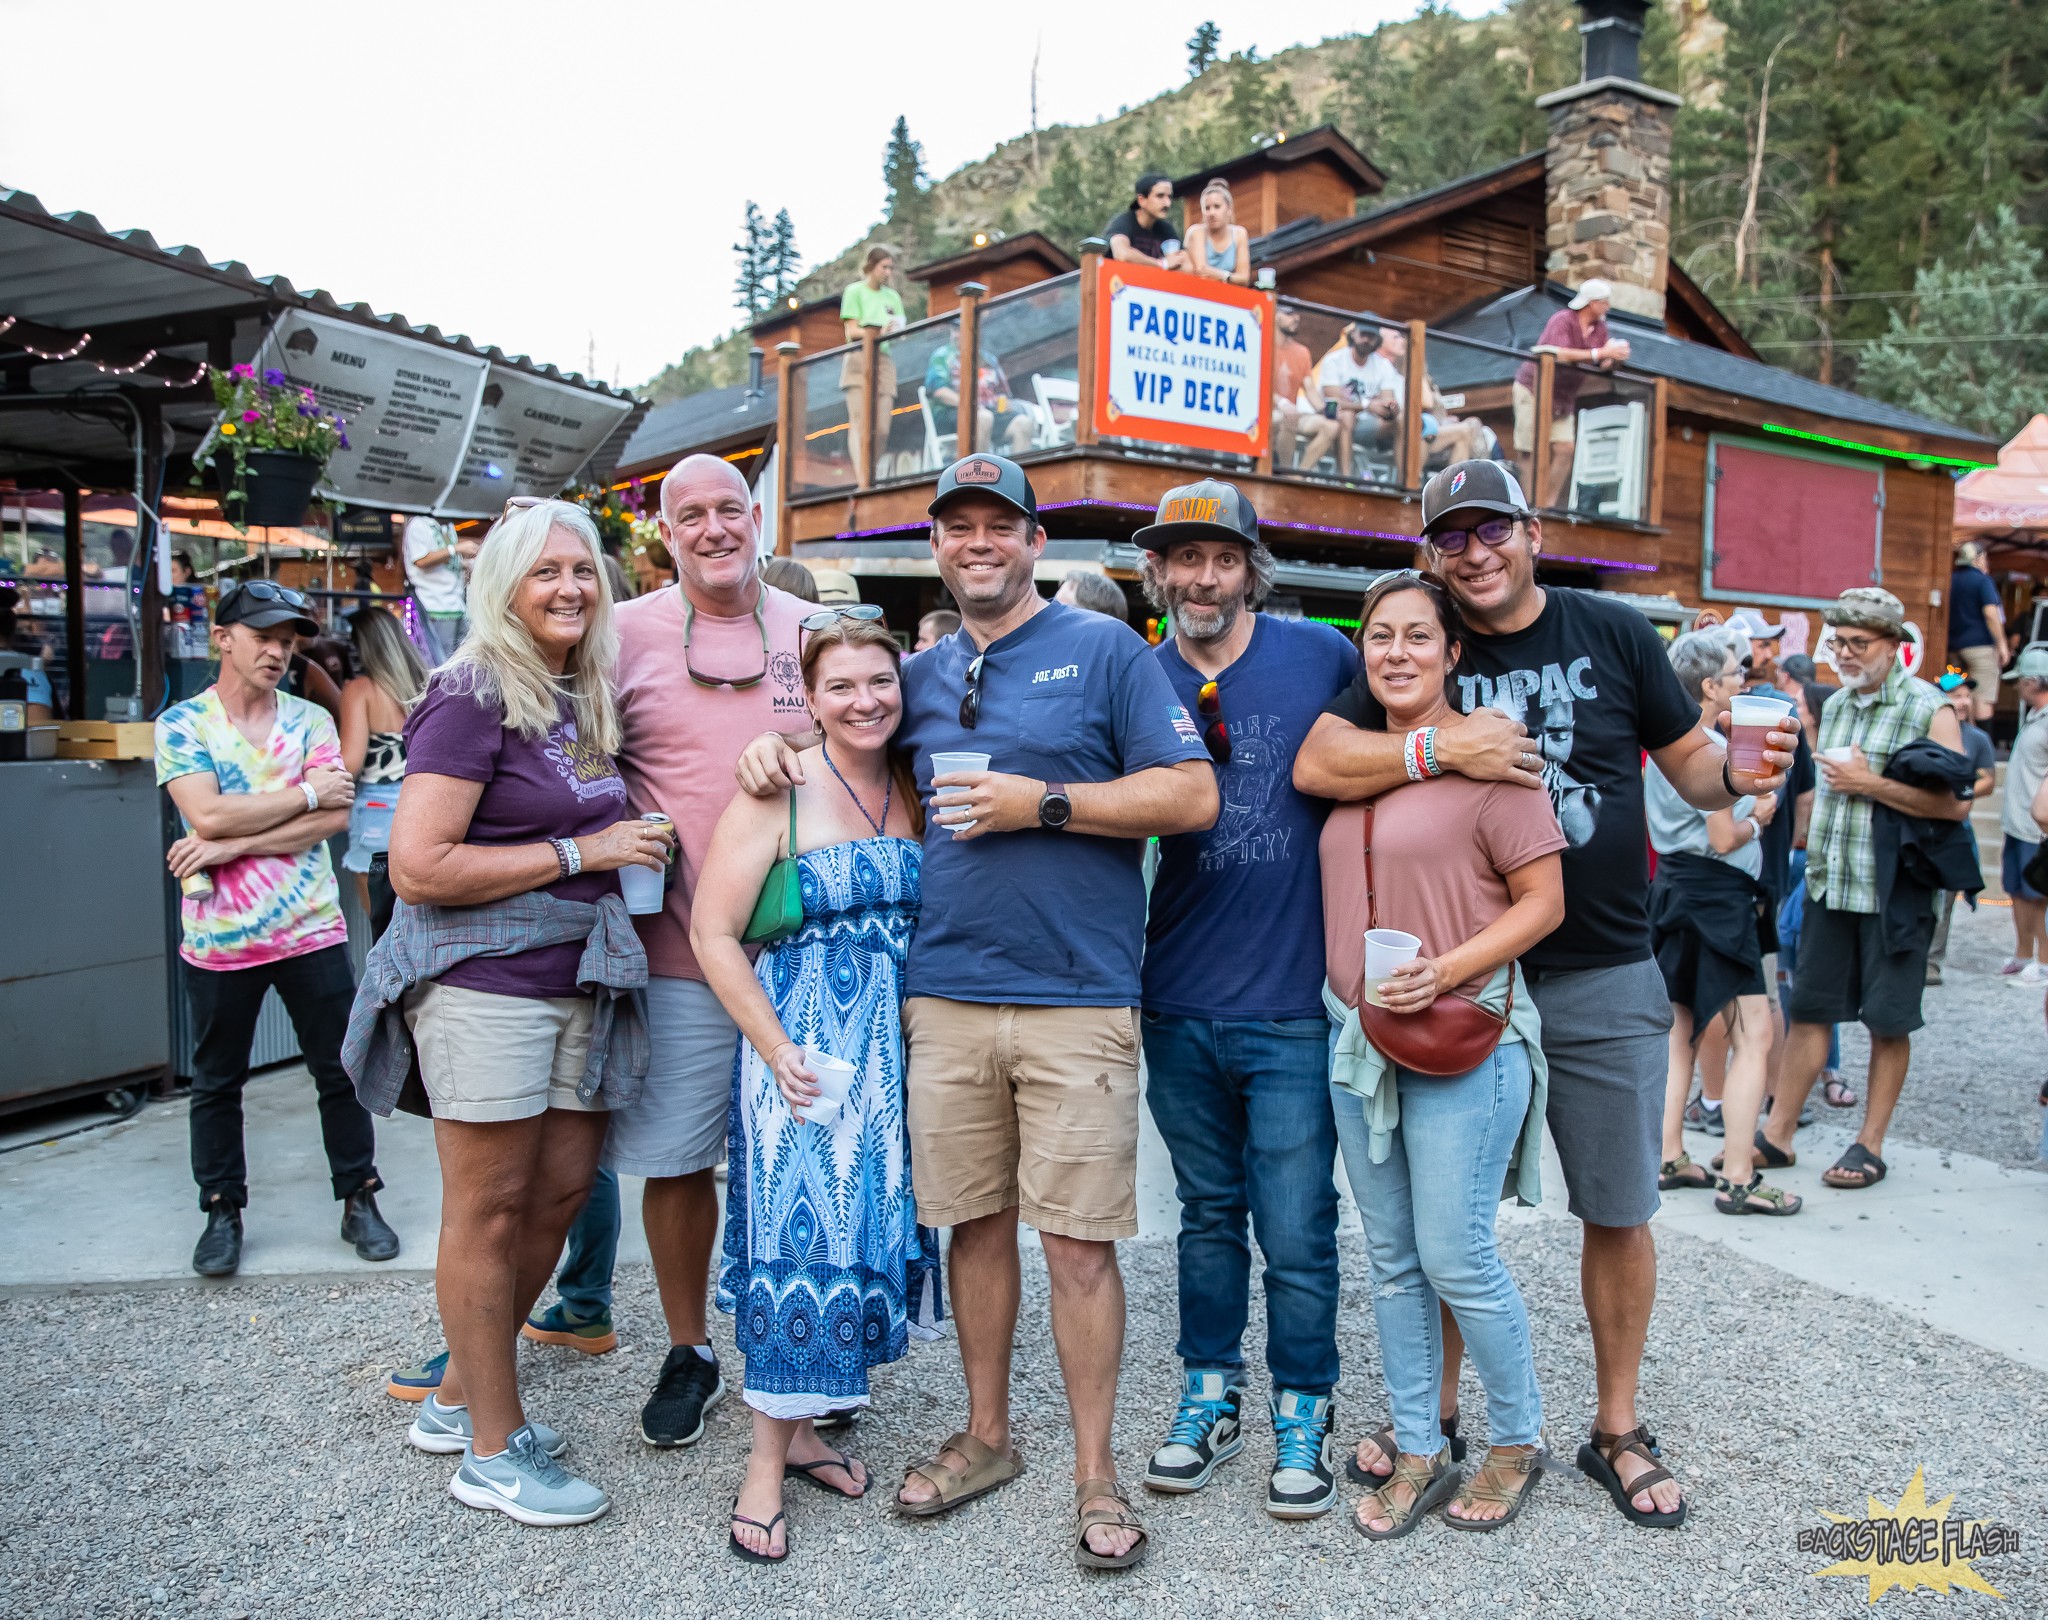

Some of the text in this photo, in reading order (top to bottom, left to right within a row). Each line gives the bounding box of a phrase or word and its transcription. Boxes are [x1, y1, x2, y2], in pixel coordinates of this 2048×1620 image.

[1129, 302, 1247, 353] PAQUERA
[330, 350, 367, 369] MENU
[1127, 345, 1247, 378] MEZCAL ARTESANAL
[396, 368, 452, 389] OTHER SNACKS
[1134, 370, 1239, 417] VIP DECK
[1032, 664, 1079, 684] JOE JOST'S
[1458, 656, 1598, 713] TUPAC
[773, 697, 805, 707] MAU
[1230, 715, 1280, 736] URF
